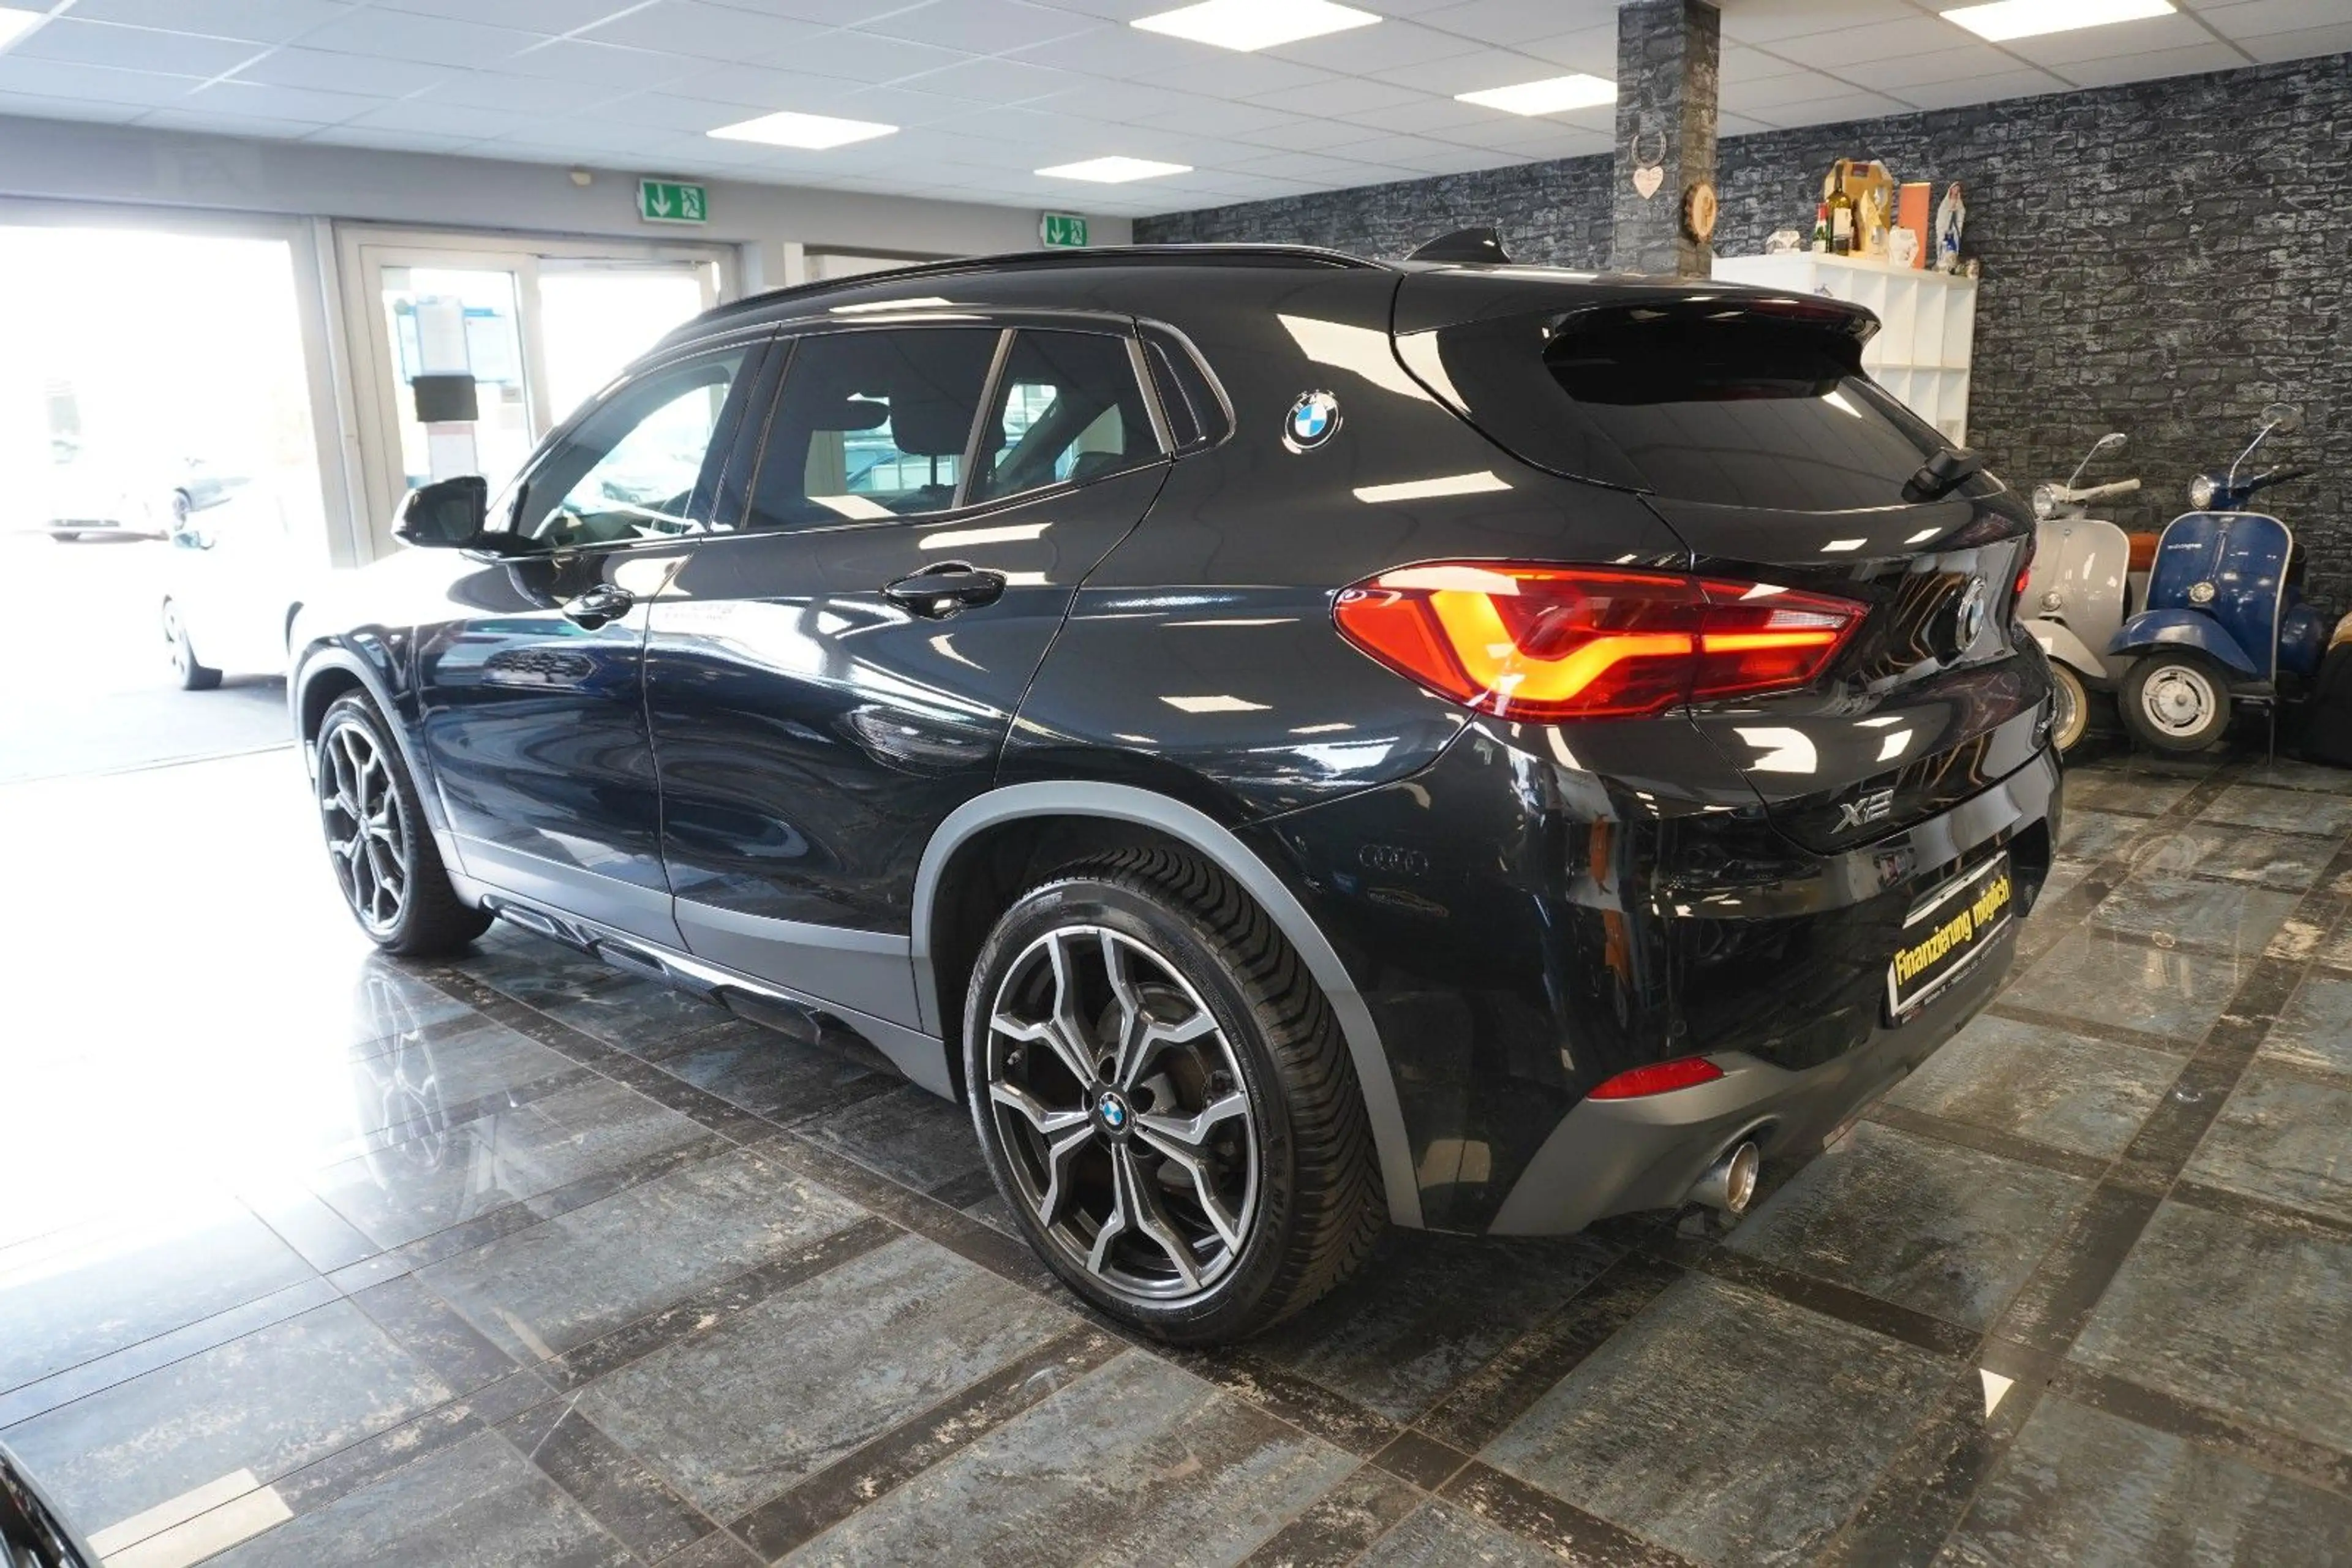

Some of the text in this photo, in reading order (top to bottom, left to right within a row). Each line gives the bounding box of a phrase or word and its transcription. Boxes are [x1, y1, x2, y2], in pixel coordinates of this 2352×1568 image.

[1828, 789, 1894, 834] X2
[1894, 910, 1972, 986] Finanzierung
[1972, 874, 2010, 928] möglich
